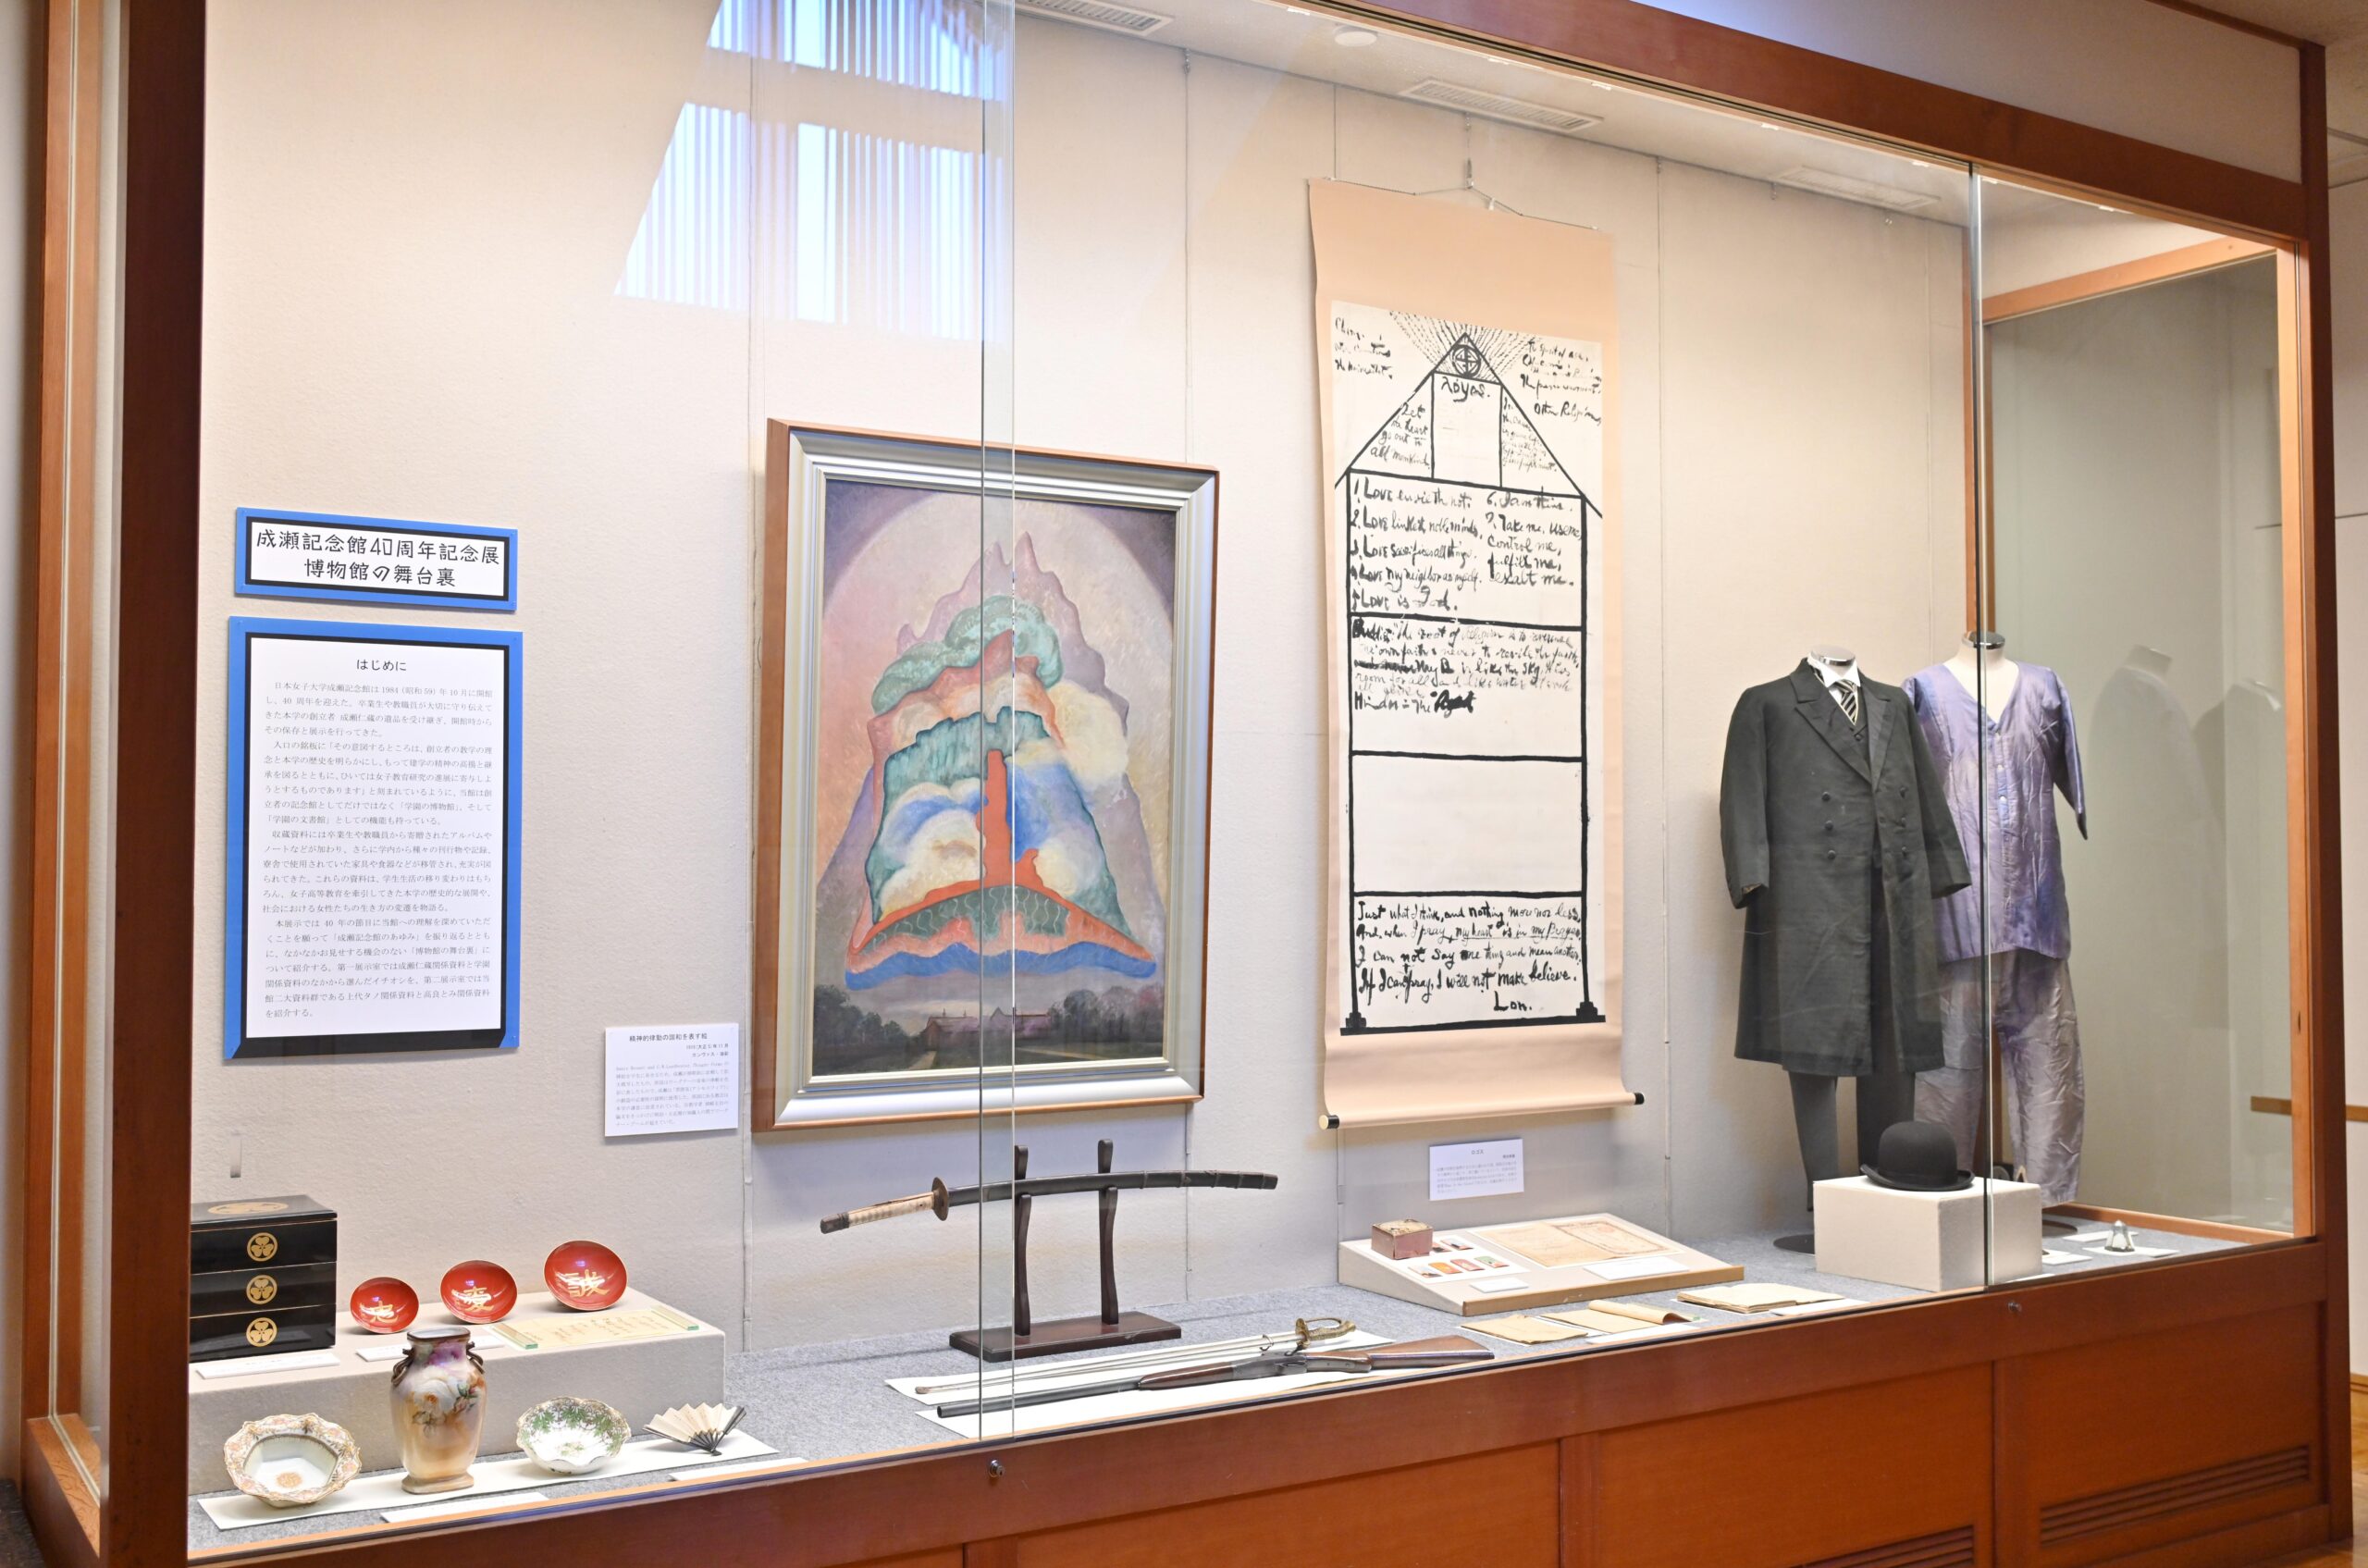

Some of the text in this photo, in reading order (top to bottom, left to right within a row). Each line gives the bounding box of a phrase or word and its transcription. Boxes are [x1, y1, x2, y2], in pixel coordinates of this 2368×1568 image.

[256, 528, 500, 565] 成瀬記念館40周年記念展
[304, 558, 456, 587] 博物館の舞台裏
[356, 658, 407, 672] はじめに
[1358, 900, 1386, 920] Just
[1498, 971, 1528, 986] make
[265, 1008, 314, 1019] を紹介する。
